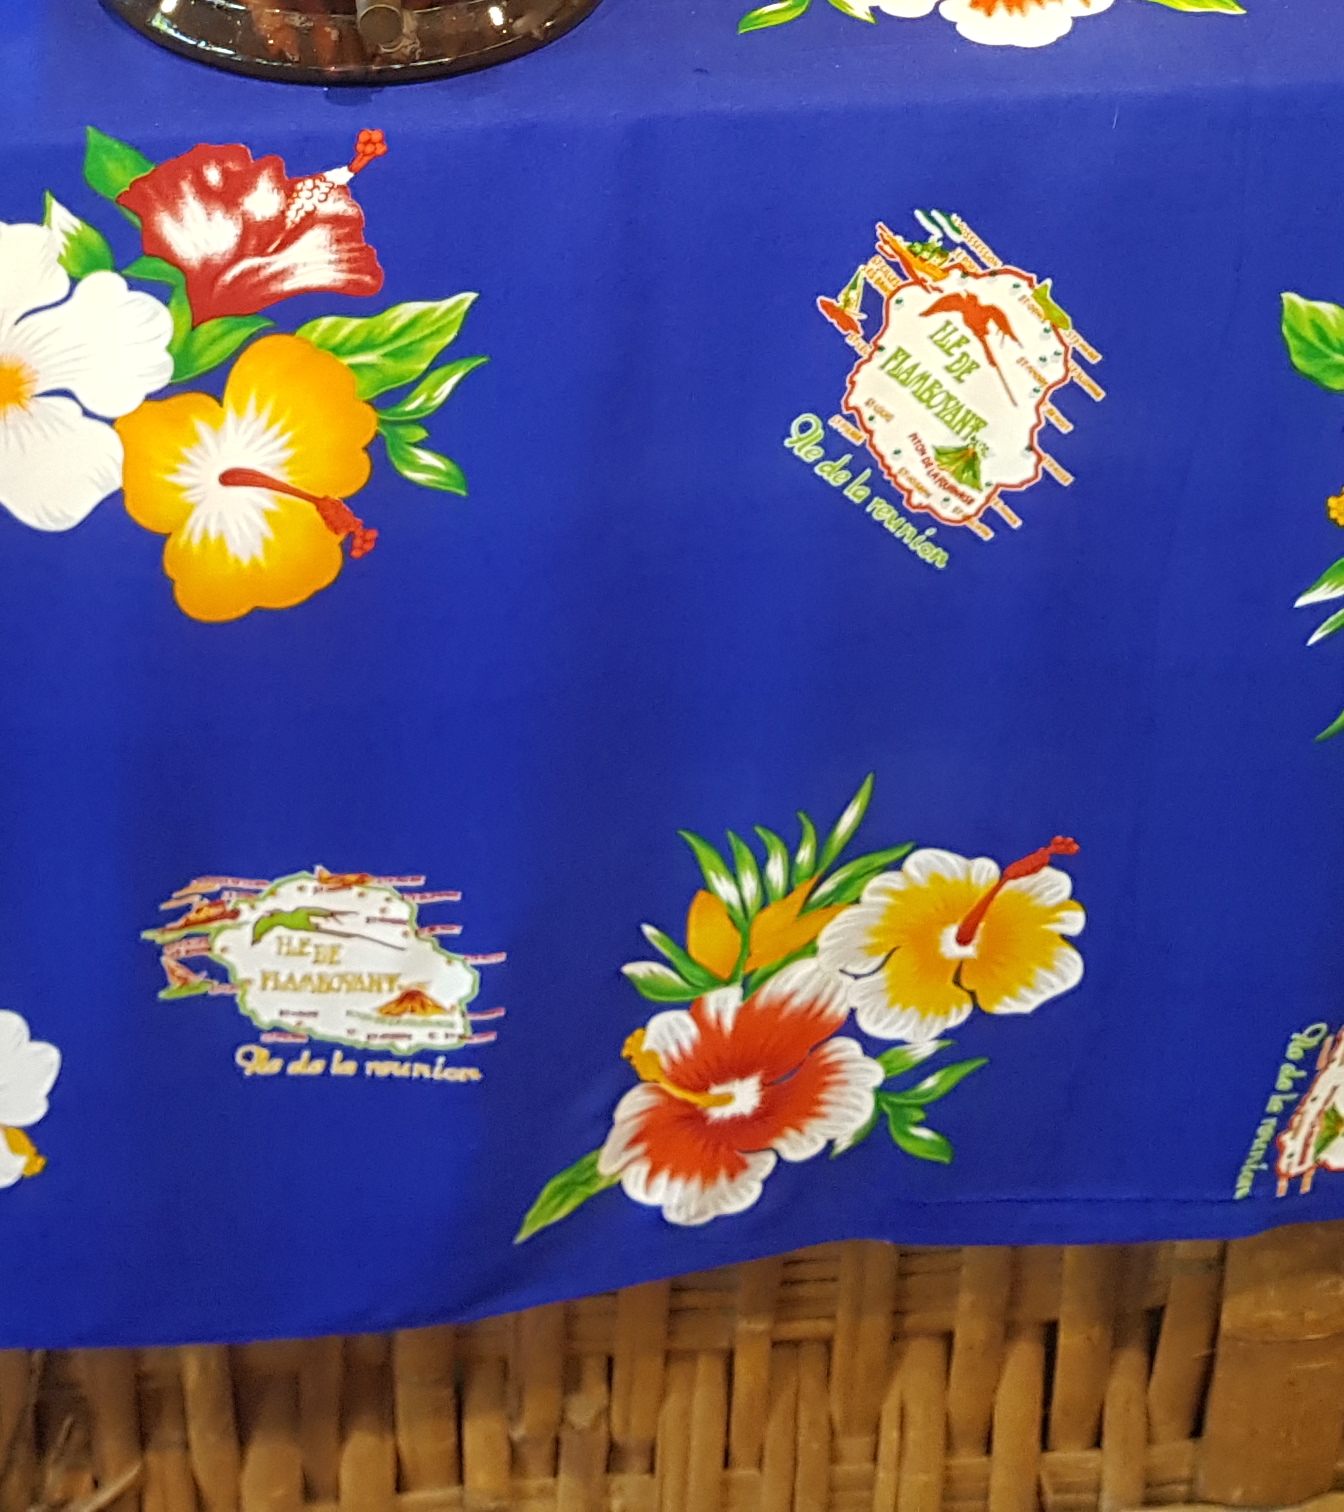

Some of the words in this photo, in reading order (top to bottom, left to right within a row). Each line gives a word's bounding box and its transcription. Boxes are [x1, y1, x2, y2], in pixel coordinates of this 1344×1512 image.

[928, 320, 970, 358] ILE
[944, 351, 981, 383] DE
[878, 345, 988, 441] FLAMBOYANT
[814, 454, 852, 487] de
[843, 468, 871, 503] la
[866, 496, 950, 569] reunion
